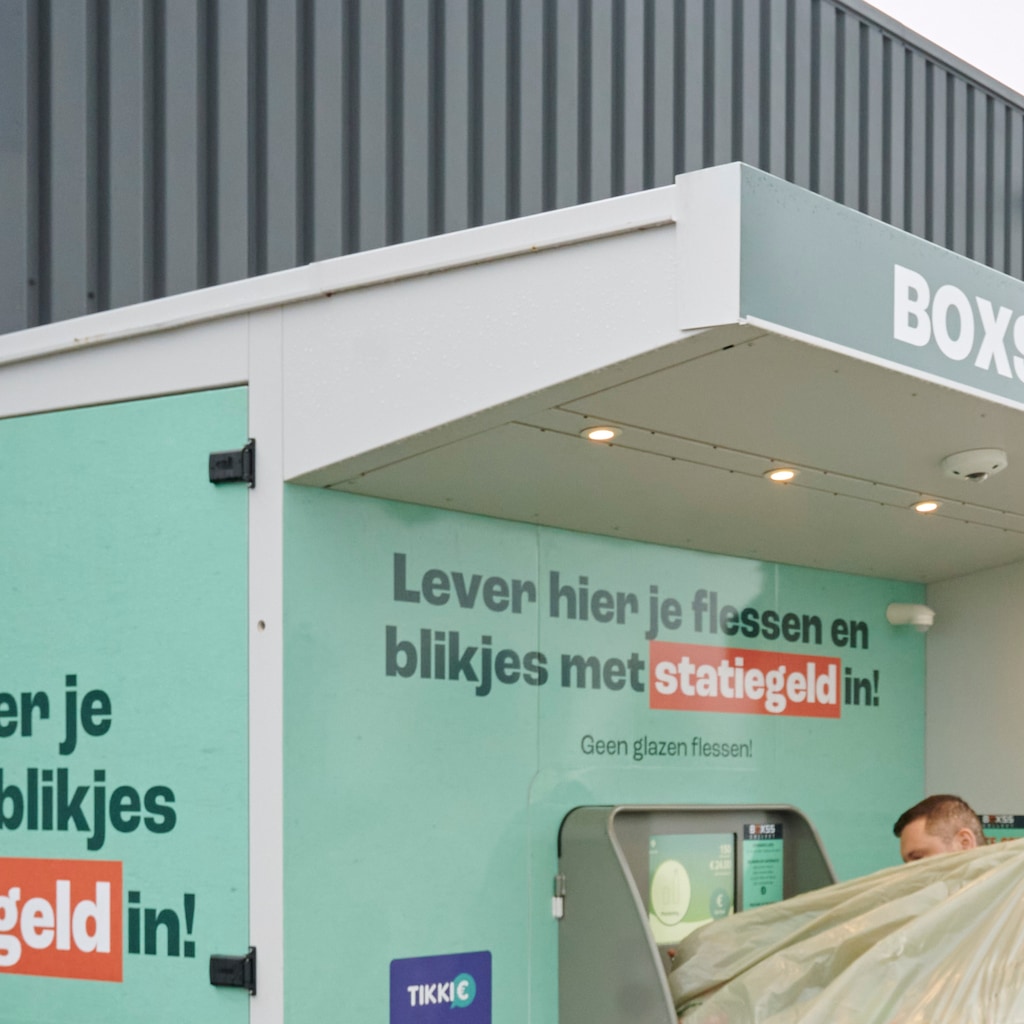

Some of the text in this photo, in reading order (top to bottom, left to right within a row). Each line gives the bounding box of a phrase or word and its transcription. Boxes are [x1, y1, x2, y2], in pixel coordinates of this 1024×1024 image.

[392, 552, 869, 650] Lever hier je flessen en
[385, 625, 881, 714] blikjes met statiegeld in!
[59, 674, 112, 756] je
[581, 734, 753, 761] Geen glazen flessen!
[0, 767, 177, 851] blikjes
[749, 823, 776, 834] BOXSS
[128, 890, 196, 958] in!
